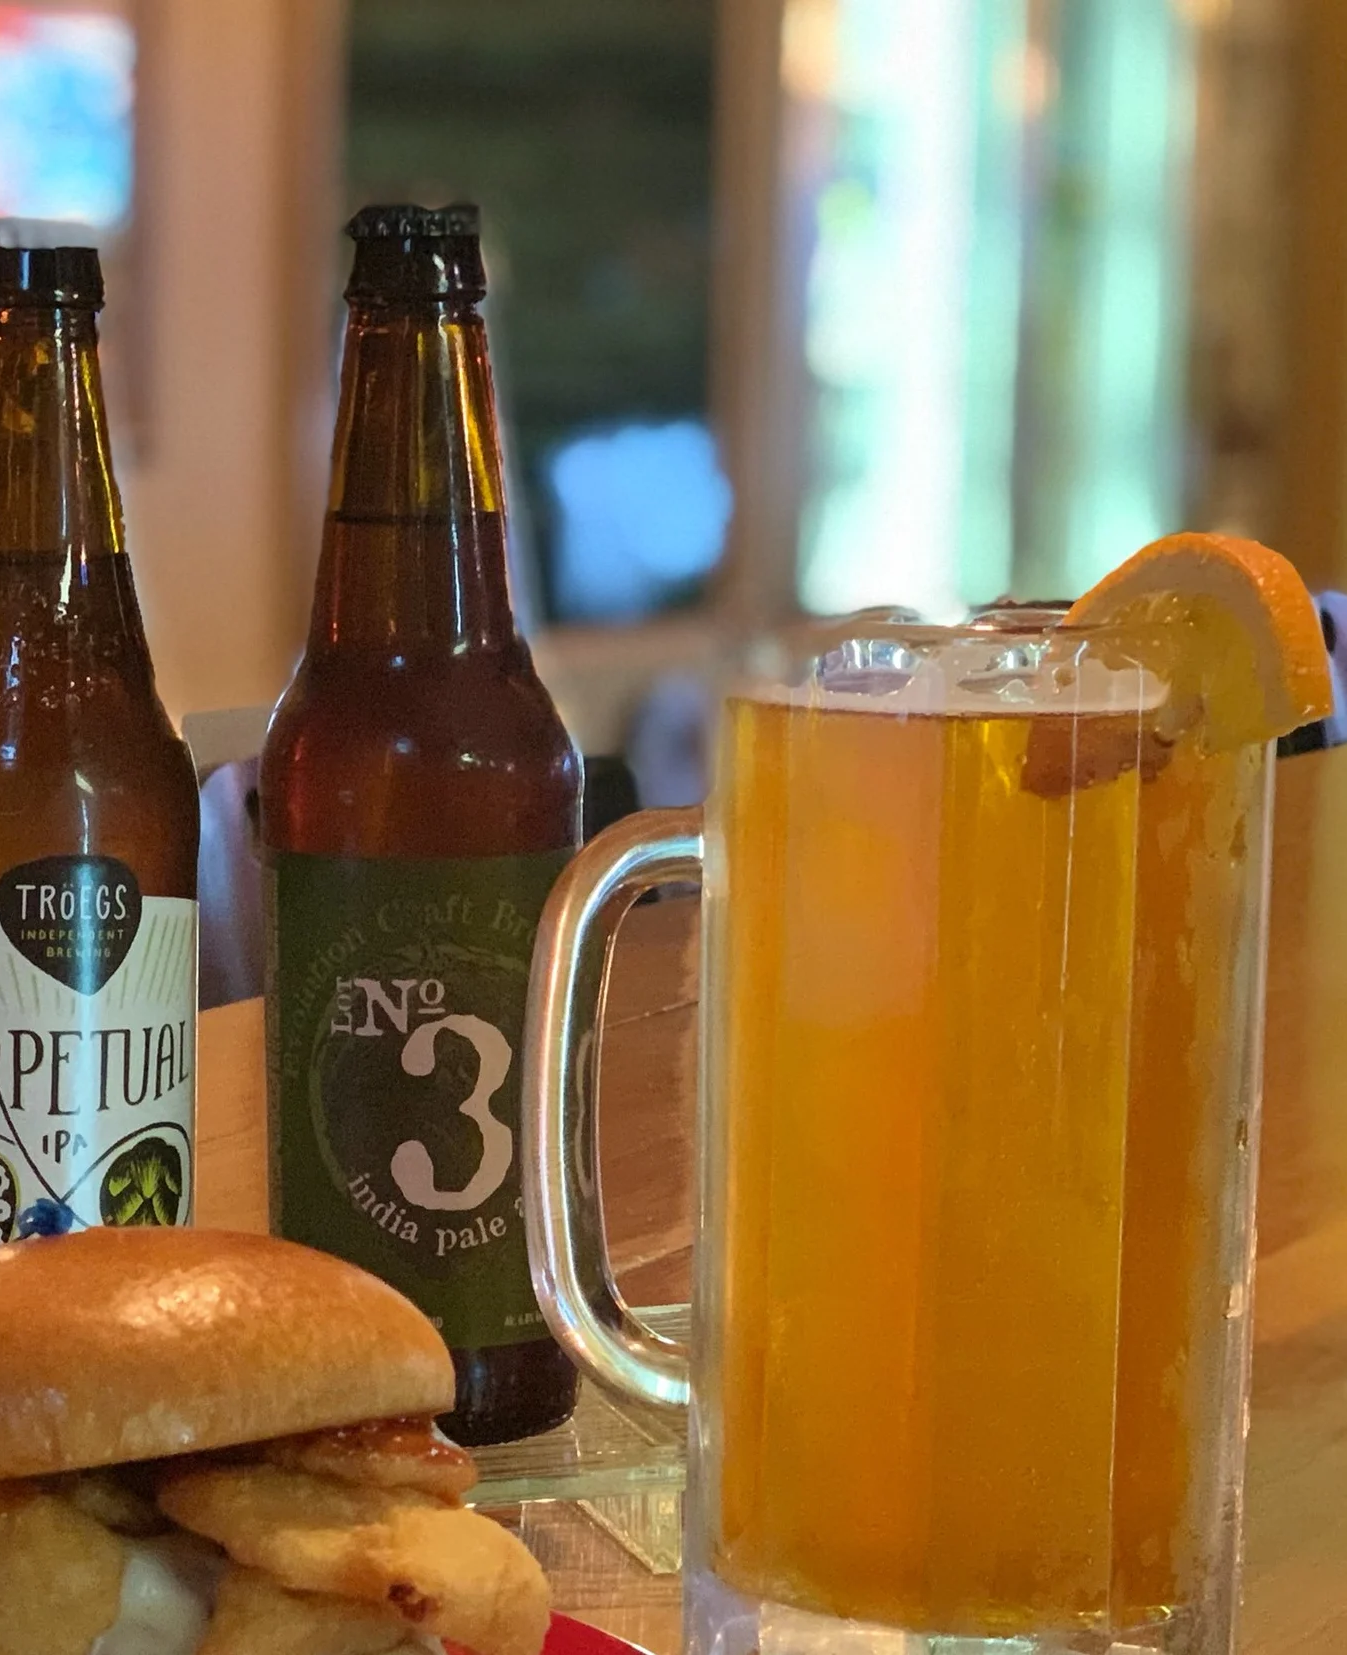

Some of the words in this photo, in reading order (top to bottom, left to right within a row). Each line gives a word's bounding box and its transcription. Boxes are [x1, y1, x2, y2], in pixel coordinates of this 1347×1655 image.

[331, 976, 353, 1038] LOT
[42, 1129, 88, 1165] IPA
[391, 1014, 512, 1211] 3
[349, 1172, 419, 1245] india
[435, 1213, 507, 1257] pale
